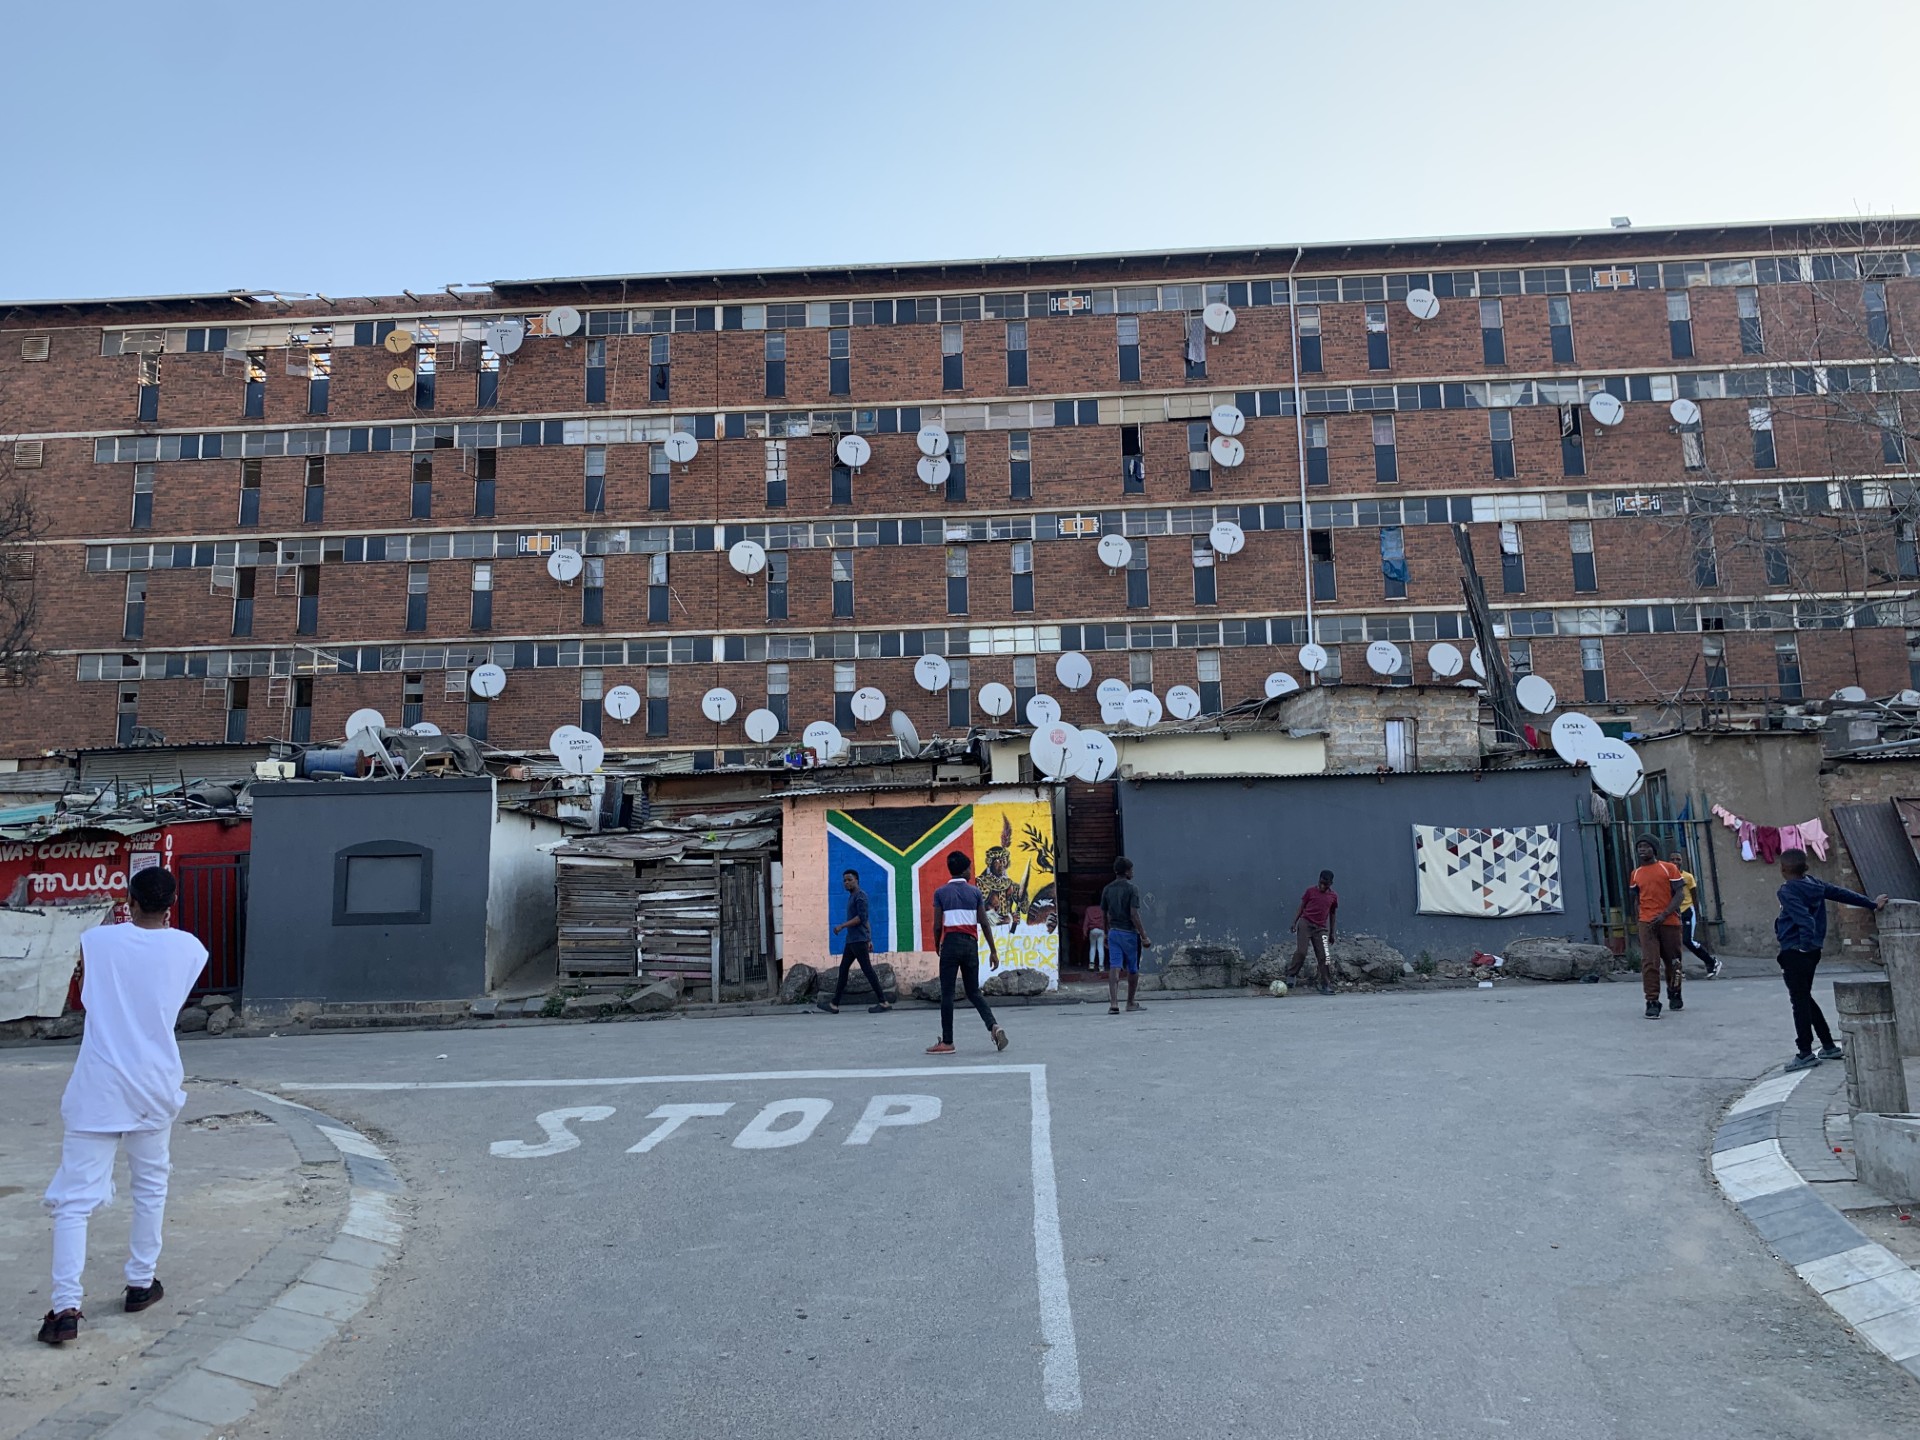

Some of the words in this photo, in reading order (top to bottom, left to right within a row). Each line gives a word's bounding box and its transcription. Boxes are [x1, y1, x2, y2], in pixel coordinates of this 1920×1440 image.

[38, 841, 119, 860] CORNER
[132, 842, 156, 851] HIRE
[27, 864, 128, 893] mula
[489, 1094, 943, 1158] STOP
